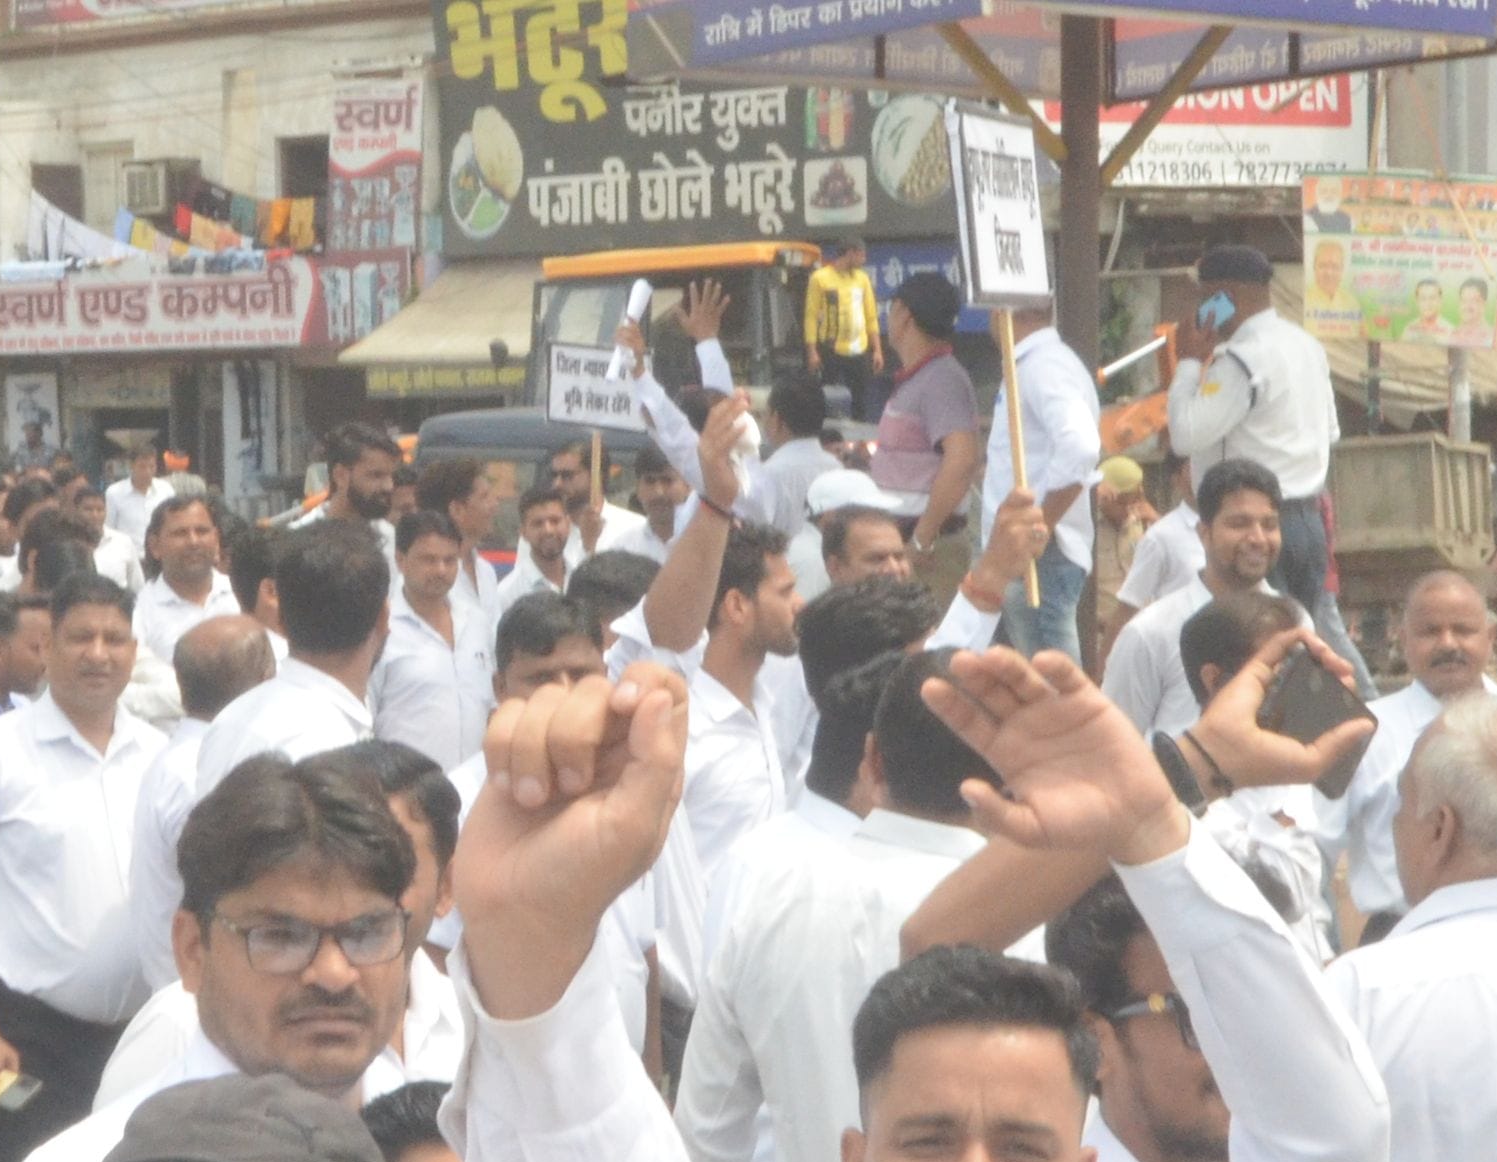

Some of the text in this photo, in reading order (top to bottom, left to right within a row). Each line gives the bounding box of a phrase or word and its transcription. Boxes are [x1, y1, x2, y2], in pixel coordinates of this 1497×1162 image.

[705, 14, 742, 45] रात्रि
[770, 4, 813, 33] डिपर
[819, 2, 842, 25] का
[333, 83, 420, 133] स्वर्ण
[623, 80, 789, 151] पनीर युक्त
[1148, 140, 1183, 155] Query
[1187, 140, 1232, 152] Contact
[1235, 141, 1251, 152] Us
[1254, 144, 1271, 153] on
[527, 142, 797, 235] पंजाबी छोले भटूरे
[75, 283, 150, 328] एण्ड
[157, 264, 295, 321] कम्पनी
